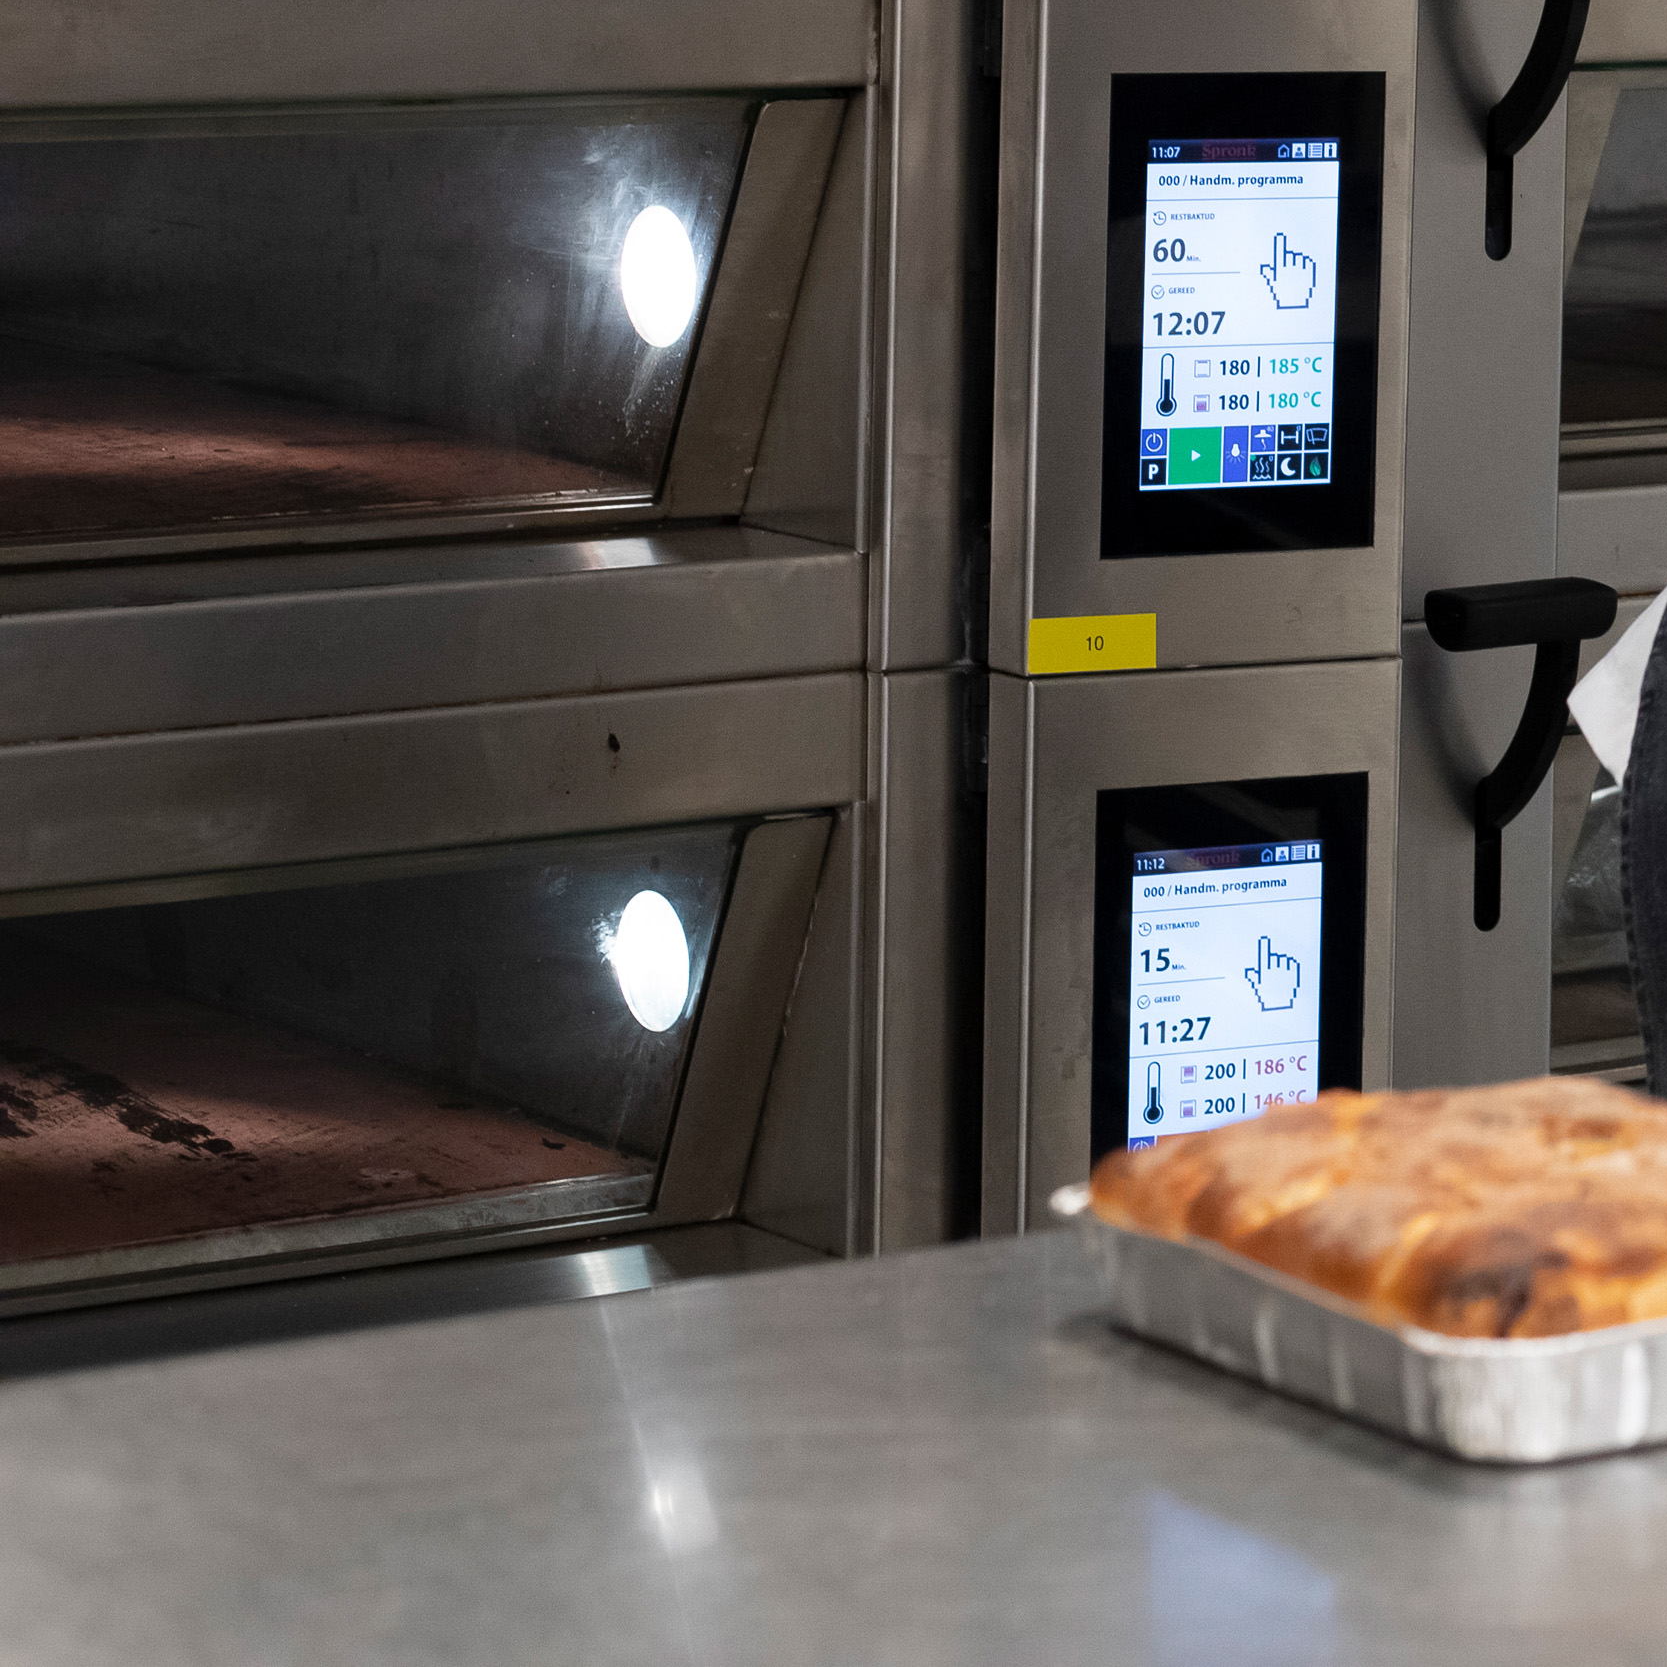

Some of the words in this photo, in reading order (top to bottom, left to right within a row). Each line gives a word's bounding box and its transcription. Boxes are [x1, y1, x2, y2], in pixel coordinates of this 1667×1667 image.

[1152, 146, 1180, 158] 11:07
[1159, 176, 1180, 186] 000
[1190, 174, 1234, 185] Handm.
[1238, 176, 1303, 187] programma
[1153, 238, 1185, 262] 60
[1153, 311, 1225, 336] 12:07
[1220, 360, 1250, 375] 180
[1270, 358, 1299, 374] 185
[1304, 357, 1322, 373] °C
[1219, 394, 1249, 410] 180
[1269, 393, 1298, 408] 180
[1303, 391, 1321, 407] °C
[1148, 464, 1159, 480] P
[1086, 635, 1105, 651] 10
[1137, 858, 1165, 870] 11:12
[1144, 886, 1165, 898] 000
[1175, 883, 1219, 895] Handm.
[1222, 879, 1286, 894] programma
[1141, 948, 1170, 972] 15
[1154, 995, 1180, 1003] GEREED
[1139, 1017, 1211, 1045] 11:27
[1205, 1063, 1235, 1080] 200
[1255, 1058, 1284, 1075] 186
[1289, 1055, 1307, 1071] °C
[1204, 1097, 1235, 1114] 200
[1254, 1091, 1283, 1110] 146
